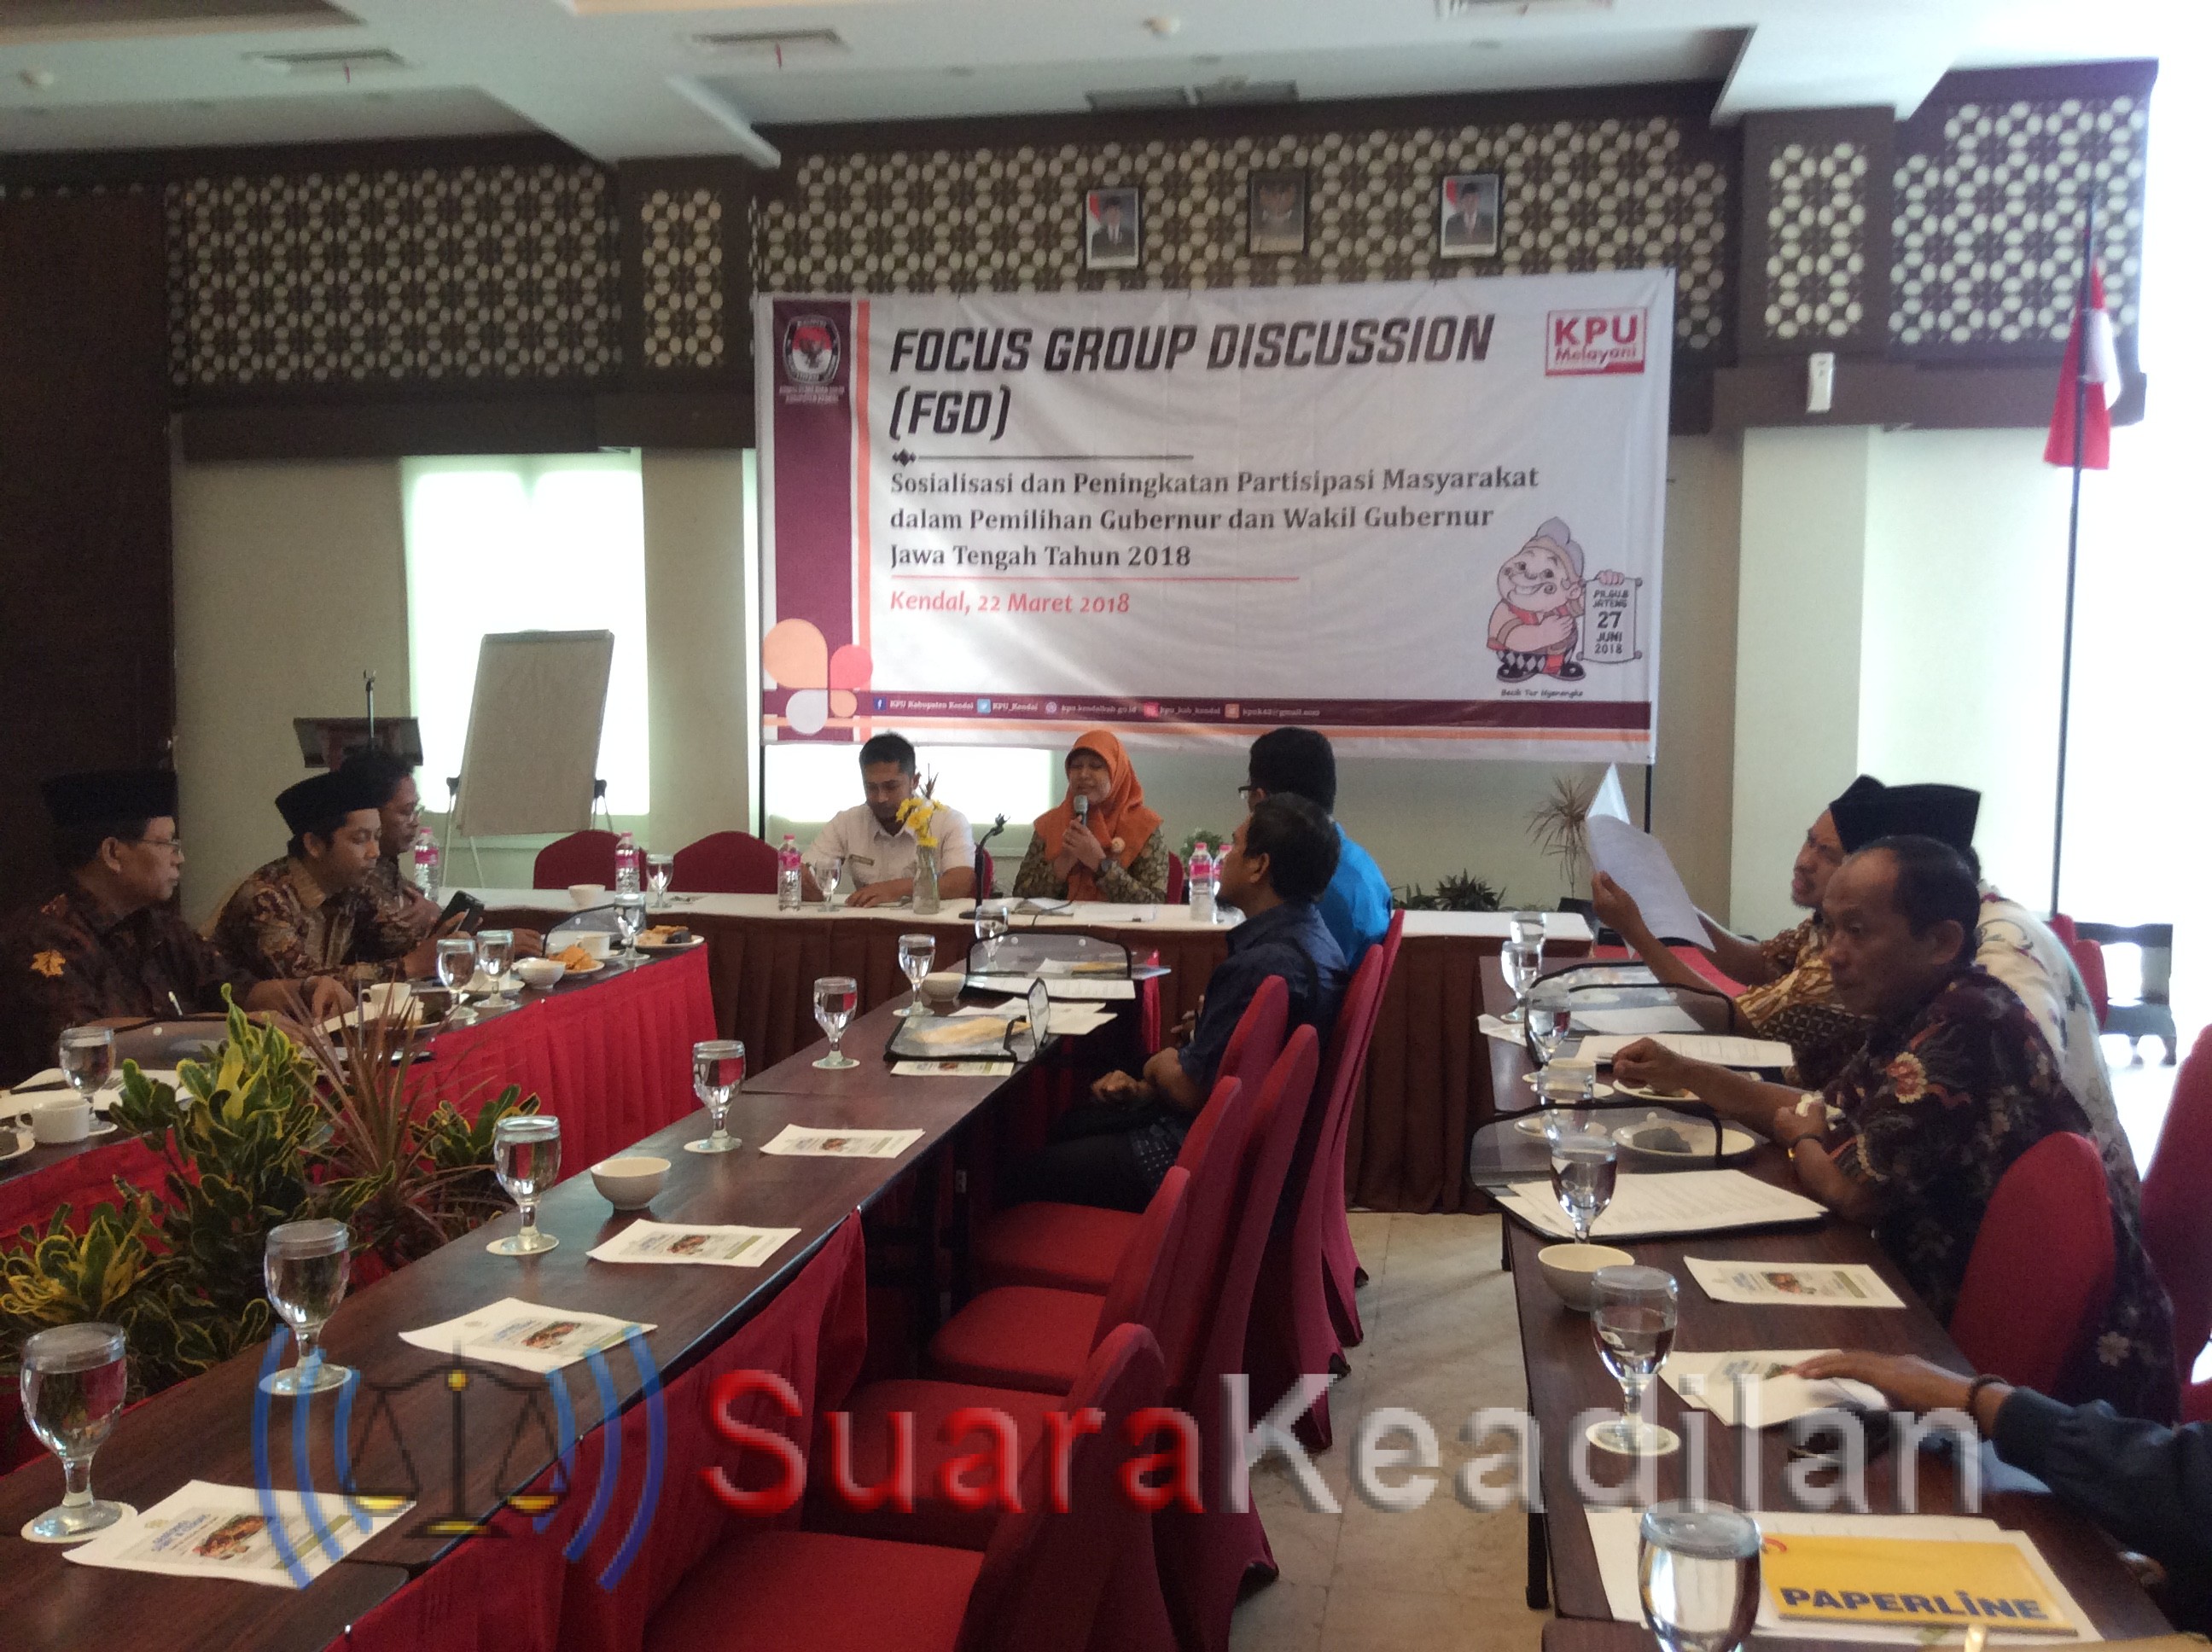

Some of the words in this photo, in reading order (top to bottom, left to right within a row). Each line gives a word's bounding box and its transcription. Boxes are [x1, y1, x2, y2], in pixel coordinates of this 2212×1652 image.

[1555, 314, 1638, 346] KPU
[890, 326, 1032, 374] FOCUS
[1045, 324, 1197, 374] GROUP
[1208, 312, 1495, 370] DISCUSSION
[1555, 344, 1637, 364] Melayani
[889, 385, 1010, 441] (FGD)
[890, 472, 1013, 494] Sosialisasi
[1021, 471, 1066, 493] dan
[1074, 472, 1229, 498] Peningkatan
[1237, 468, 1375, 496] Partisipasi
[1382, 466, 1539, 496] Masyarakat
[890, 509, 963, 531] dalam
[969, 509, 1092, 531] Pemilihan
[1100, 509, 1222, 531] Gubernur
[1229, 508, 1275, 530] dan
[1284, 507, 1357, 529] Wakil
[1365, 506, 1494, 528] Gubernur
[890, 545, 945, 568] Jawa
[953, 545, 1037, 571] Tengah
[1045, 544, 1121, 567] Tahun
[1127, 545, 1191, 567] 2018
[890, 590, 971, 615] Kendal,
[978, 595, 1001, 612] 22
[1007, 592, 1073, 613] Maret
[1080, 592, 1131, 614] 2018
[1598, 610, 1622, 629] 27
[1594, 643, 1623, 654] 2018
[1596, 631, 1623, 643] JUNI
